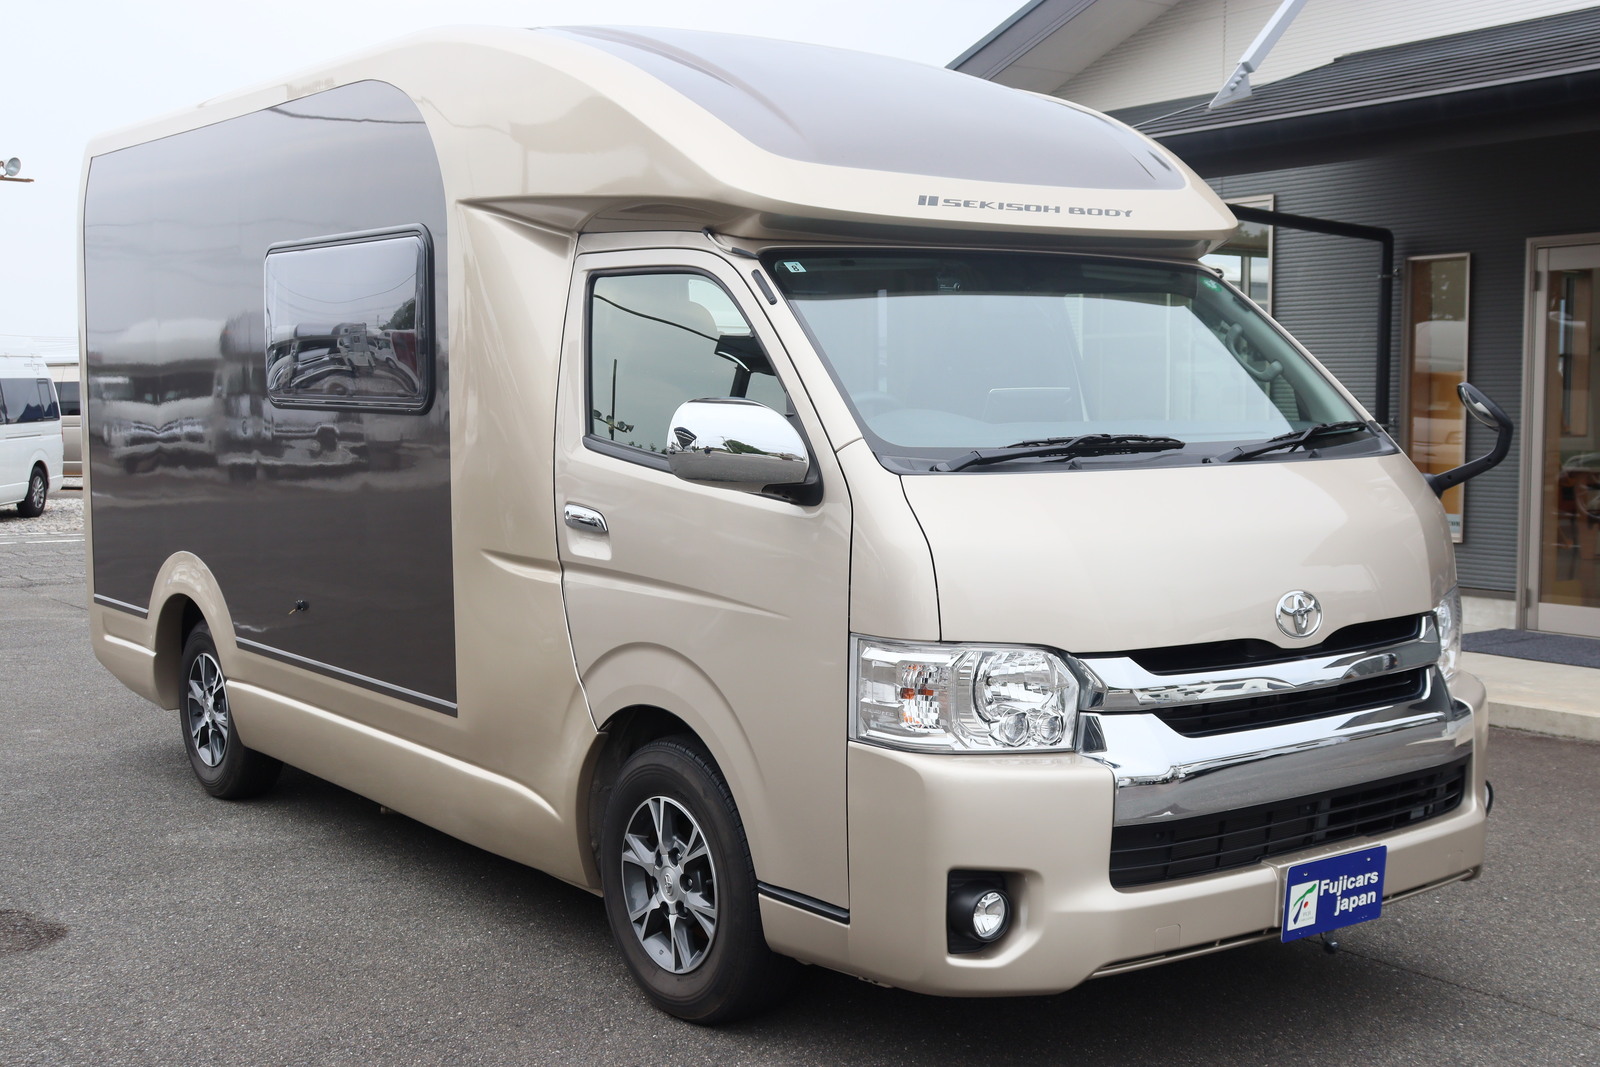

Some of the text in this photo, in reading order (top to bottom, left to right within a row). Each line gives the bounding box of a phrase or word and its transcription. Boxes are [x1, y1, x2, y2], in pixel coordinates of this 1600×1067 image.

[942, 198, 1133, 218] SEKISOH BODY
[1319, 871, 1379, 897] Fujicars
[1333, 891, 1377, 917] japan
